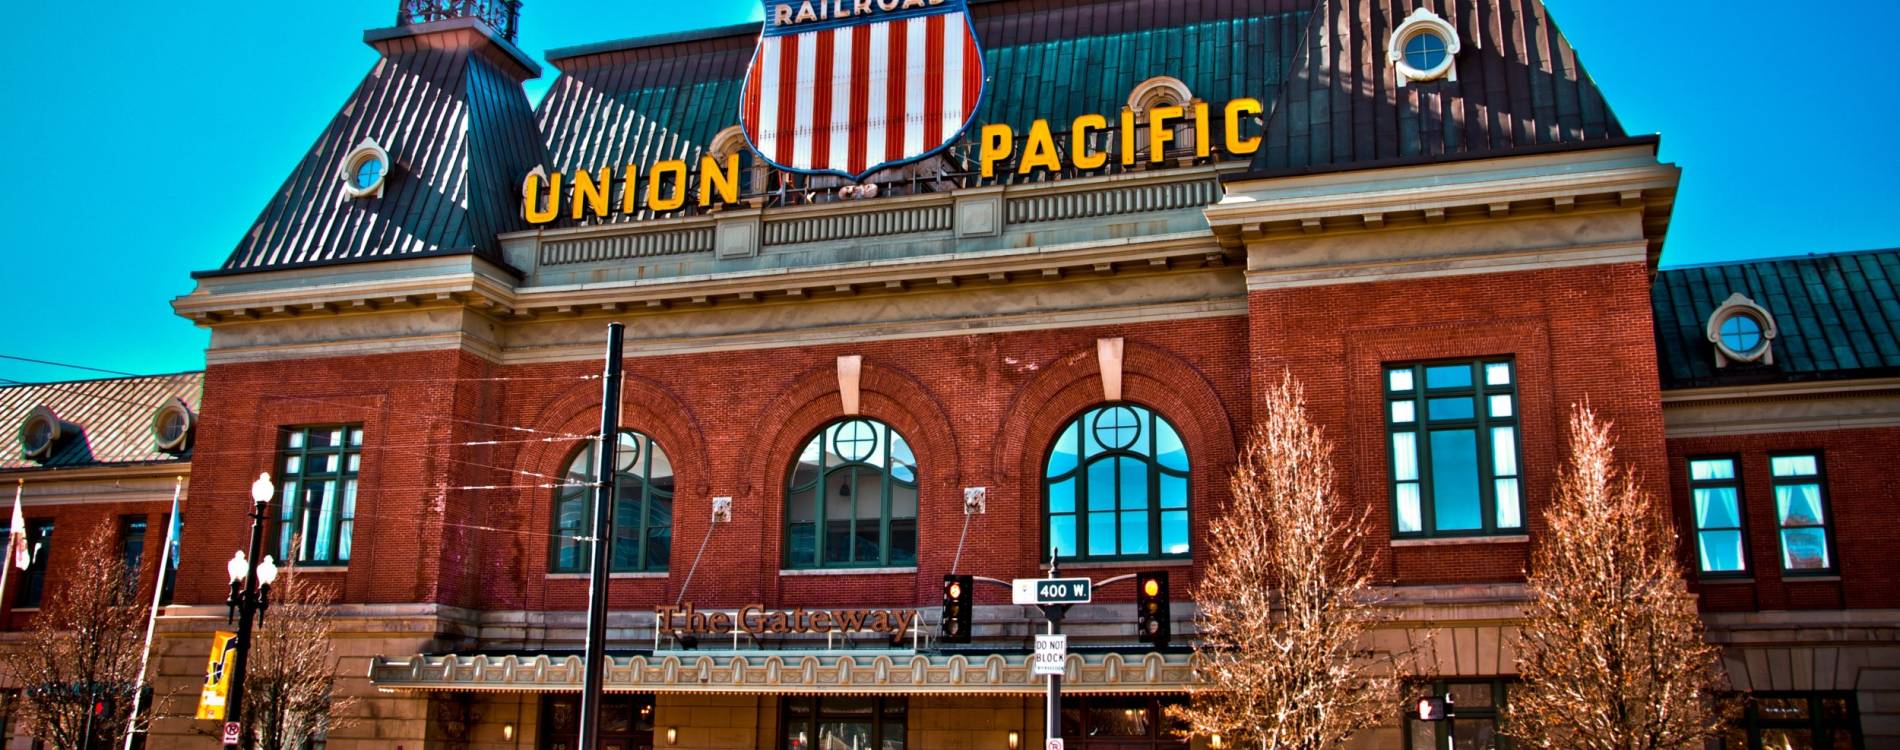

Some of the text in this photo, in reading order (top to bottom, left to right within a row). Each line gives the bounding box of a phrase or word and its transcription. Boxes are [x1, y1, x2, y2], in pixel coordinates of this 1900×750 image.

[774, 0, 944, 26] RAILRO
[524, 98, 1263, 224] UNION PACIFIC
[1040, 583, 1087, 598] 400 W.
[656, 602, 917, 643] The Gateway
[1036, 640, 1063, 650] DO NOT
[1036, 652, 1064, 662] BLOCK
